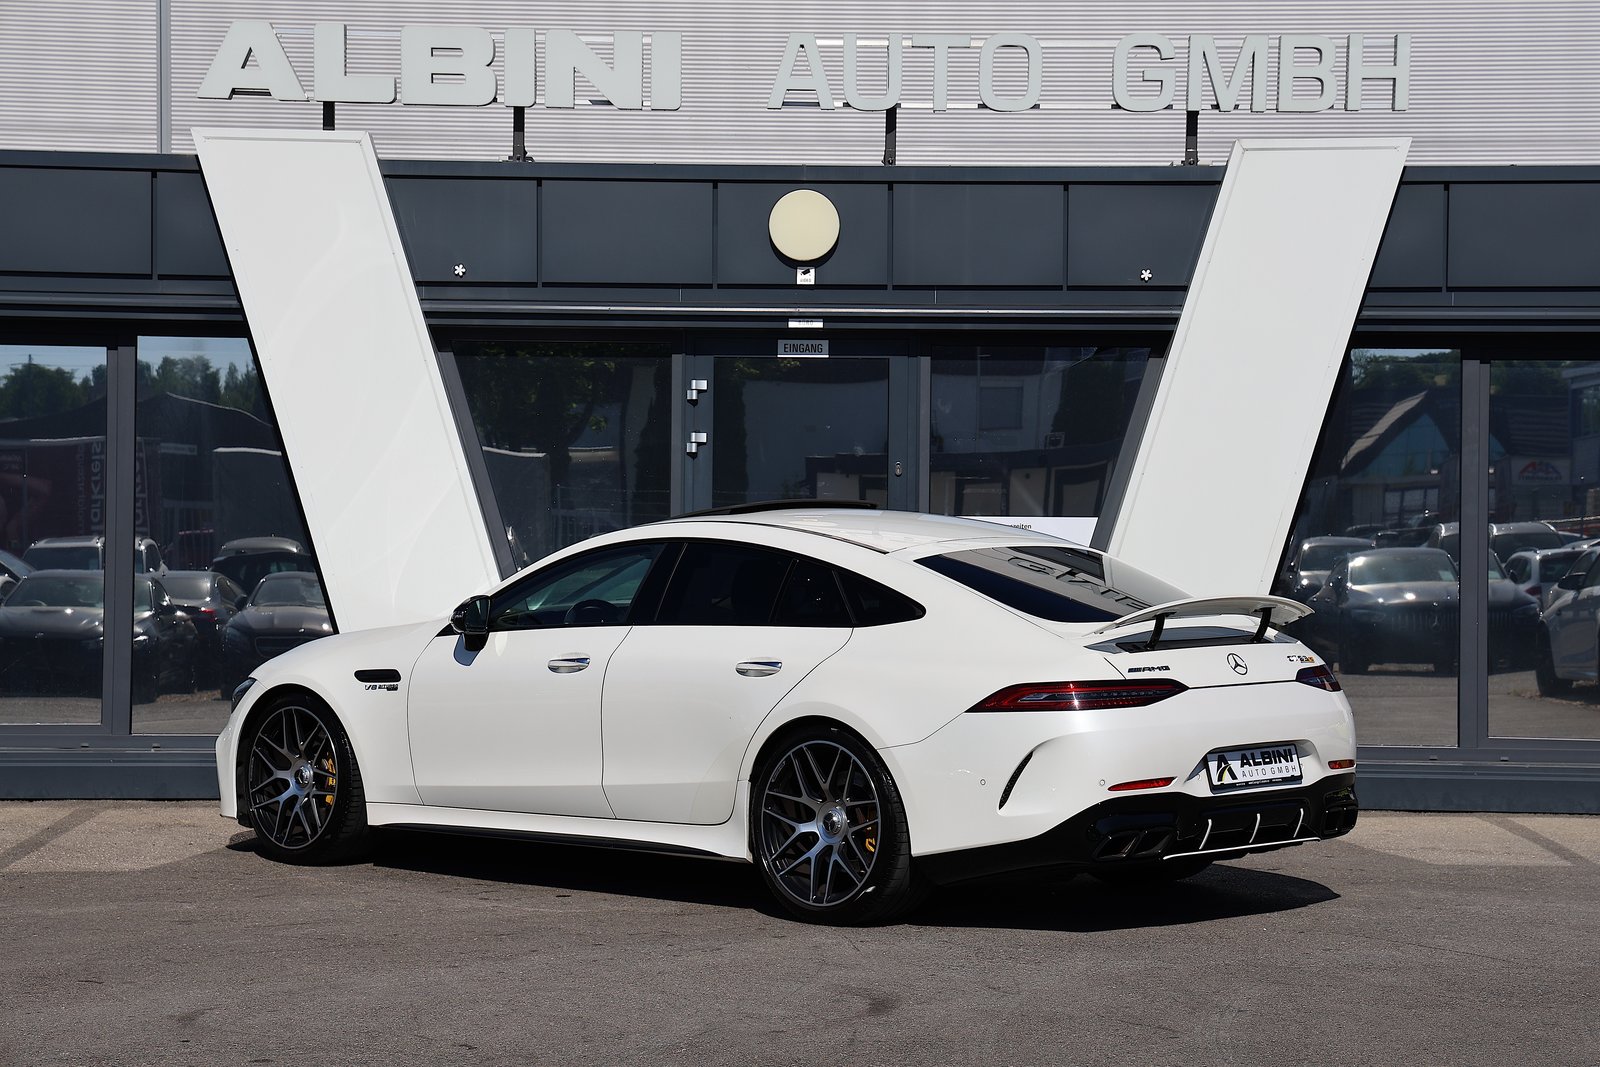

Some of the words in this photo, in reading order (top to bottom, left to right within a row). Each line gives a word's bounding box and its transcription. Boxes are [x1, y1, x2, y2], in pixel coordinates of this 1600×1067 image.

[197, 21, 682, 111] ALBINI
[768, 32, 1043, 112] AUTO
[1111, 33, 1412, 113] GMBH
[784, 343, 823, 353] EINGANG
[1240, 748, 1294, 768] ALBINI
[1242, 768, 1267, 778] AUTO
[1270, 765, 1297, 775] GMBH
